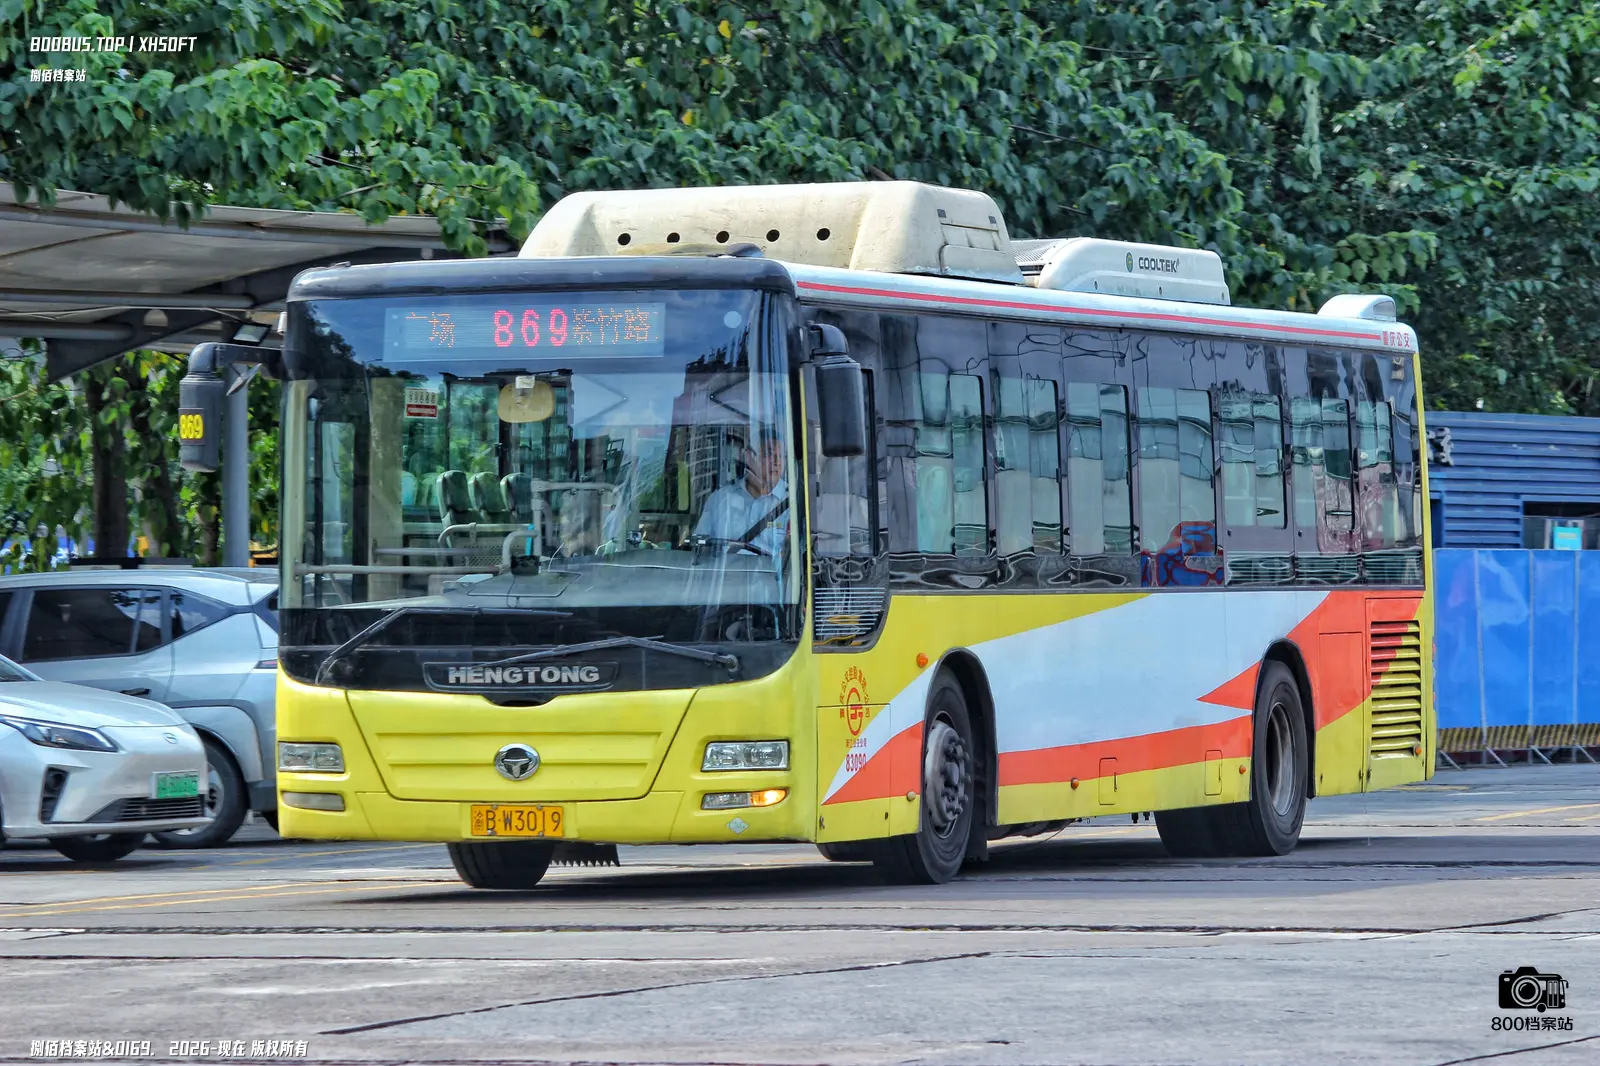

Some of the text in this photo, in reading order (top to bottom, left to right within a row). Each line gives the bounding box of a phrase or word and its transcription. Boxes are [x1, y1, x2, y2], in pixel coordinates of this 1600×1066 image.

[1138, 256, 1178, 274] COOLTEK
[493, 308, 569, 348] 869
[179, 414, 204, 439] 869
[448, 665, 600, 684] HENGTONG
[845, 753, 868, 773] 83090
